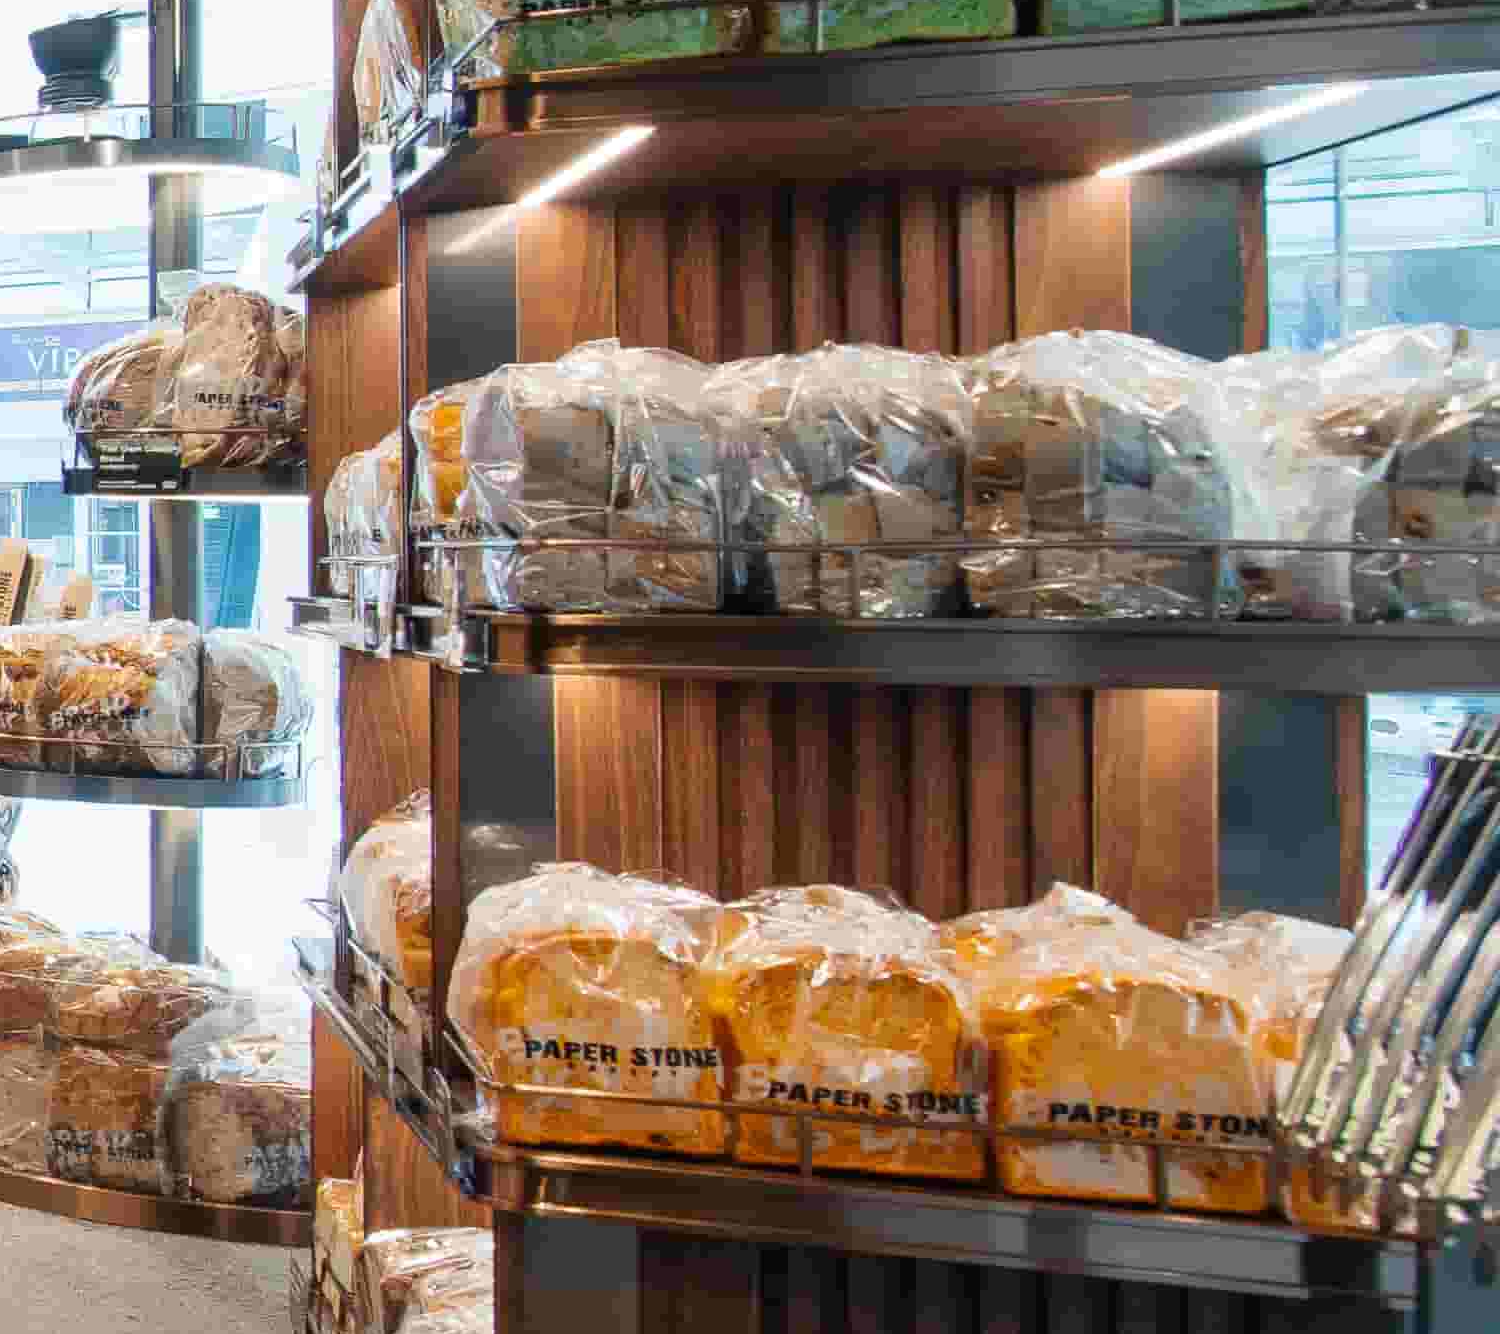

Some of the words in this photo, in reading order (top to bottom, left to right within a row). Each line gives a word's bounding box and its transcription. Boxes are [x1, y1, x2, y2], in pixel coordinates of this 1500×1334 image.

[524, 1039, 618, 1062] PAPER
[633, 1047, 718, 1068] STONE
[765, 1080, 873, 1108] PAPER
[883, 1090, 984, 1115] STONE
[1049, 1102, 1162, 1131] PAPER
[1174, 1110, 1272, 1137] STON
